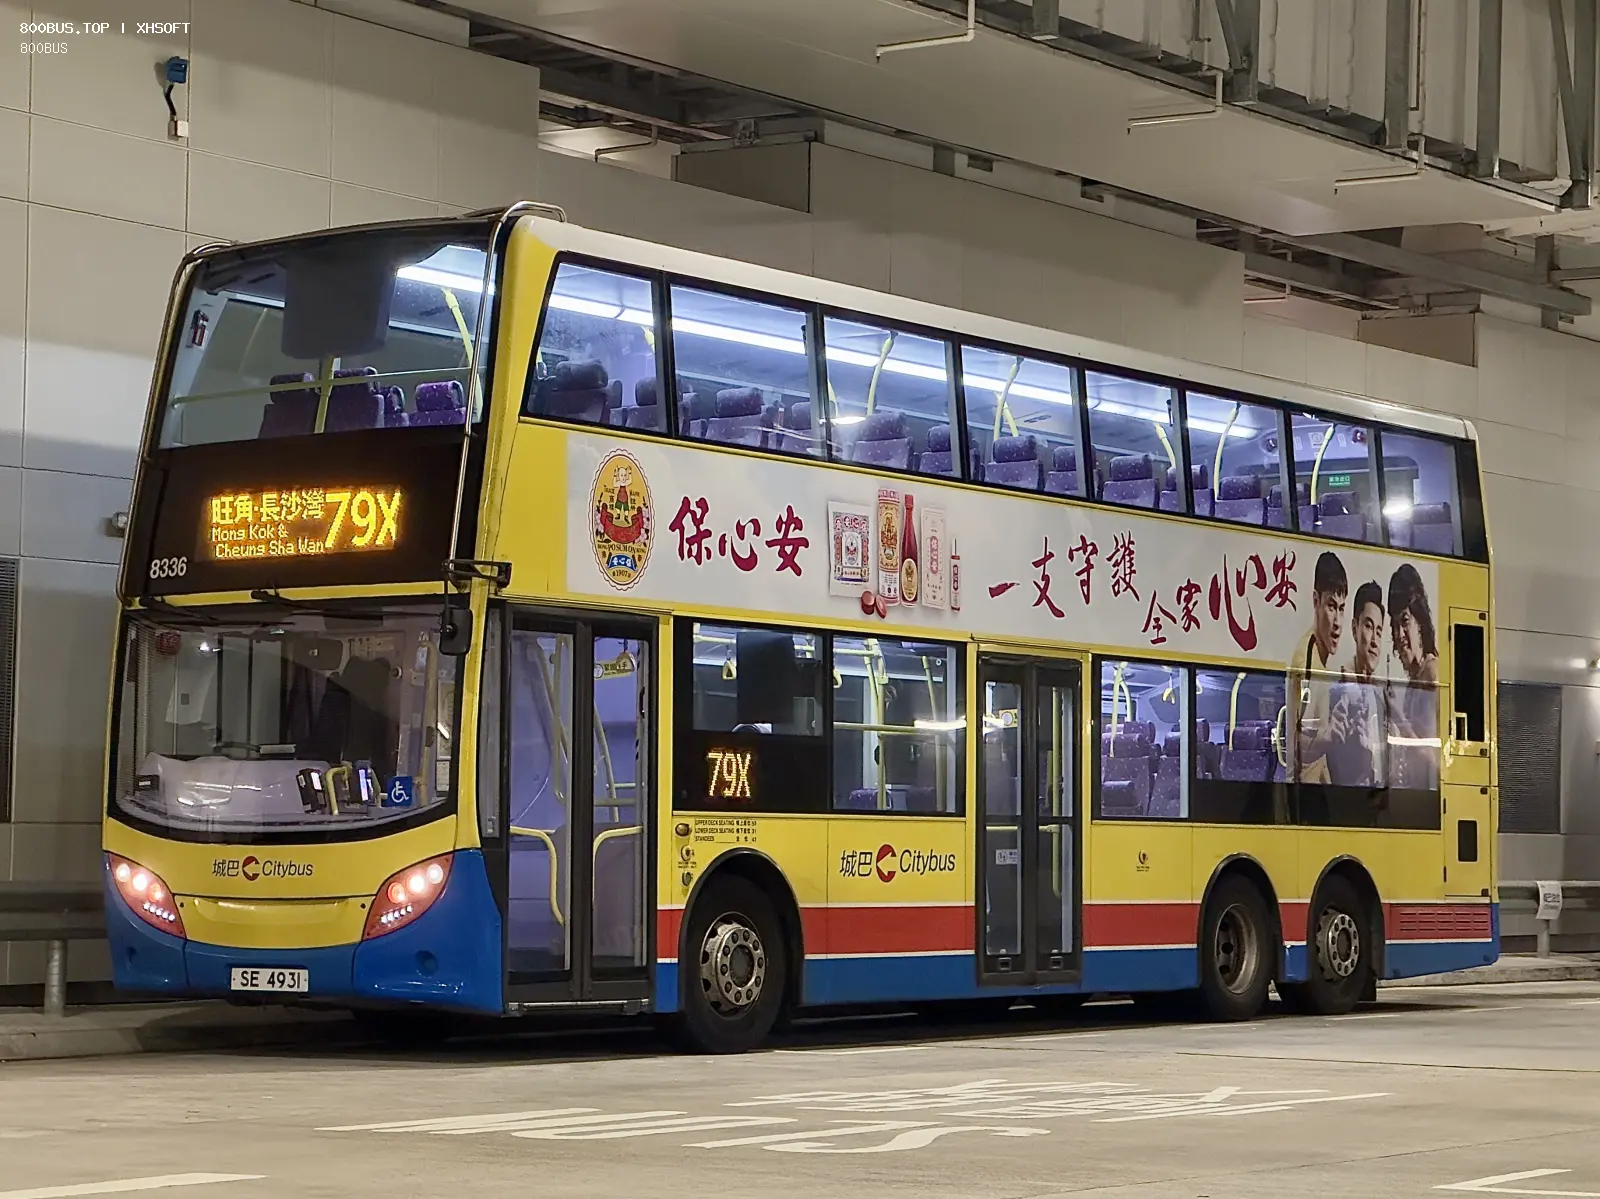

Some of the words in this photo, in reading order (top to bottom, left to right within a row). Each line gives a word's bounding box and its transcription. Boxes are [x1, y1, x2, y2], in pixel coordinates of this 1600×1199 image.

[212, 527, 246, 542] Mong
[249, 523, 275, 540] Kok
[278, 522, 289, 539] &
[325, 490, 401, 549] 79X
[215, 543, 266, 558] Cheung
[269, 540, 295, 556] Sha
[298, 537, 324, 555] Wan
[669, 496, 810, 577] 保心安
[150, 556, 188, 579] 8336
[988, 530, 1140, 618] 一支守護
[1141, 547, 1298, 652] 全家心安
[707, 752, 751, 798] 79X
[212, 859, 240, 877] 城巴
[262, 860, 314, 878] Citybus
[840, 850, 872, 877] 城巴
[899, 849, 956, 876] Citybus
[240, 970, 260, 988] SE
[267, 971, 301, 989] 4931
